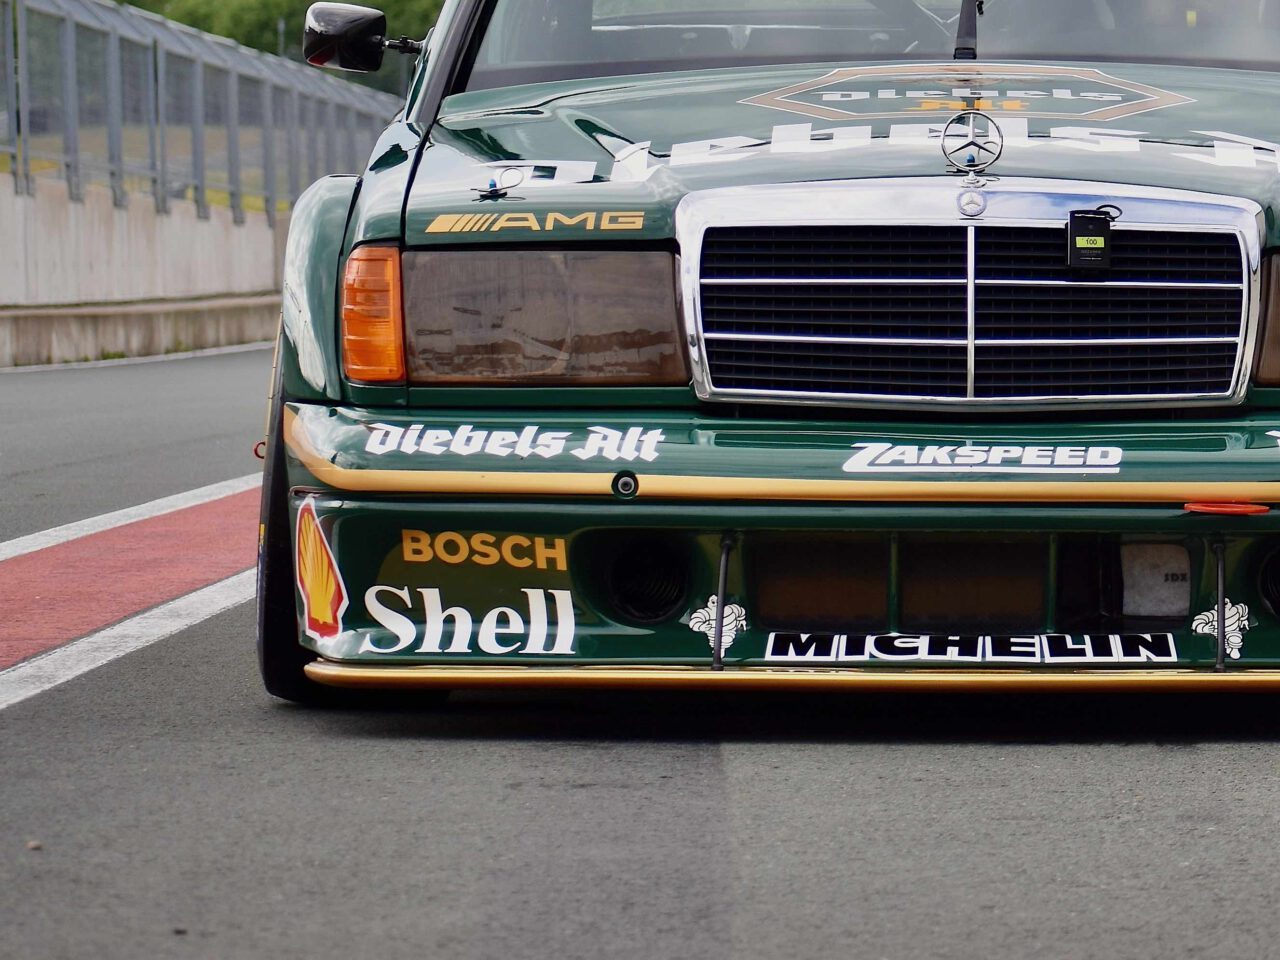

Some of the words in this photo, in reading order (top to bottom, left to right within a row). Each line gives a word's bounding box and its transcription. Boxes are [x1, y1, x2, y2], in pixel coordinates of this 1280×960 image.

[809, 87, 1127, 102] Diebels
[493, 211, 646, 231] AMG
[363, 422, 572, 458] Diebels
[570, 426, 666, 462] Alt
[841, 442, 1124, 473] ZAKSPEED
[401, 528, 568, 571] BOSCH
[359, 584, 577, 655] Shell
[764, 631, 1179, 663] MICHELIN
